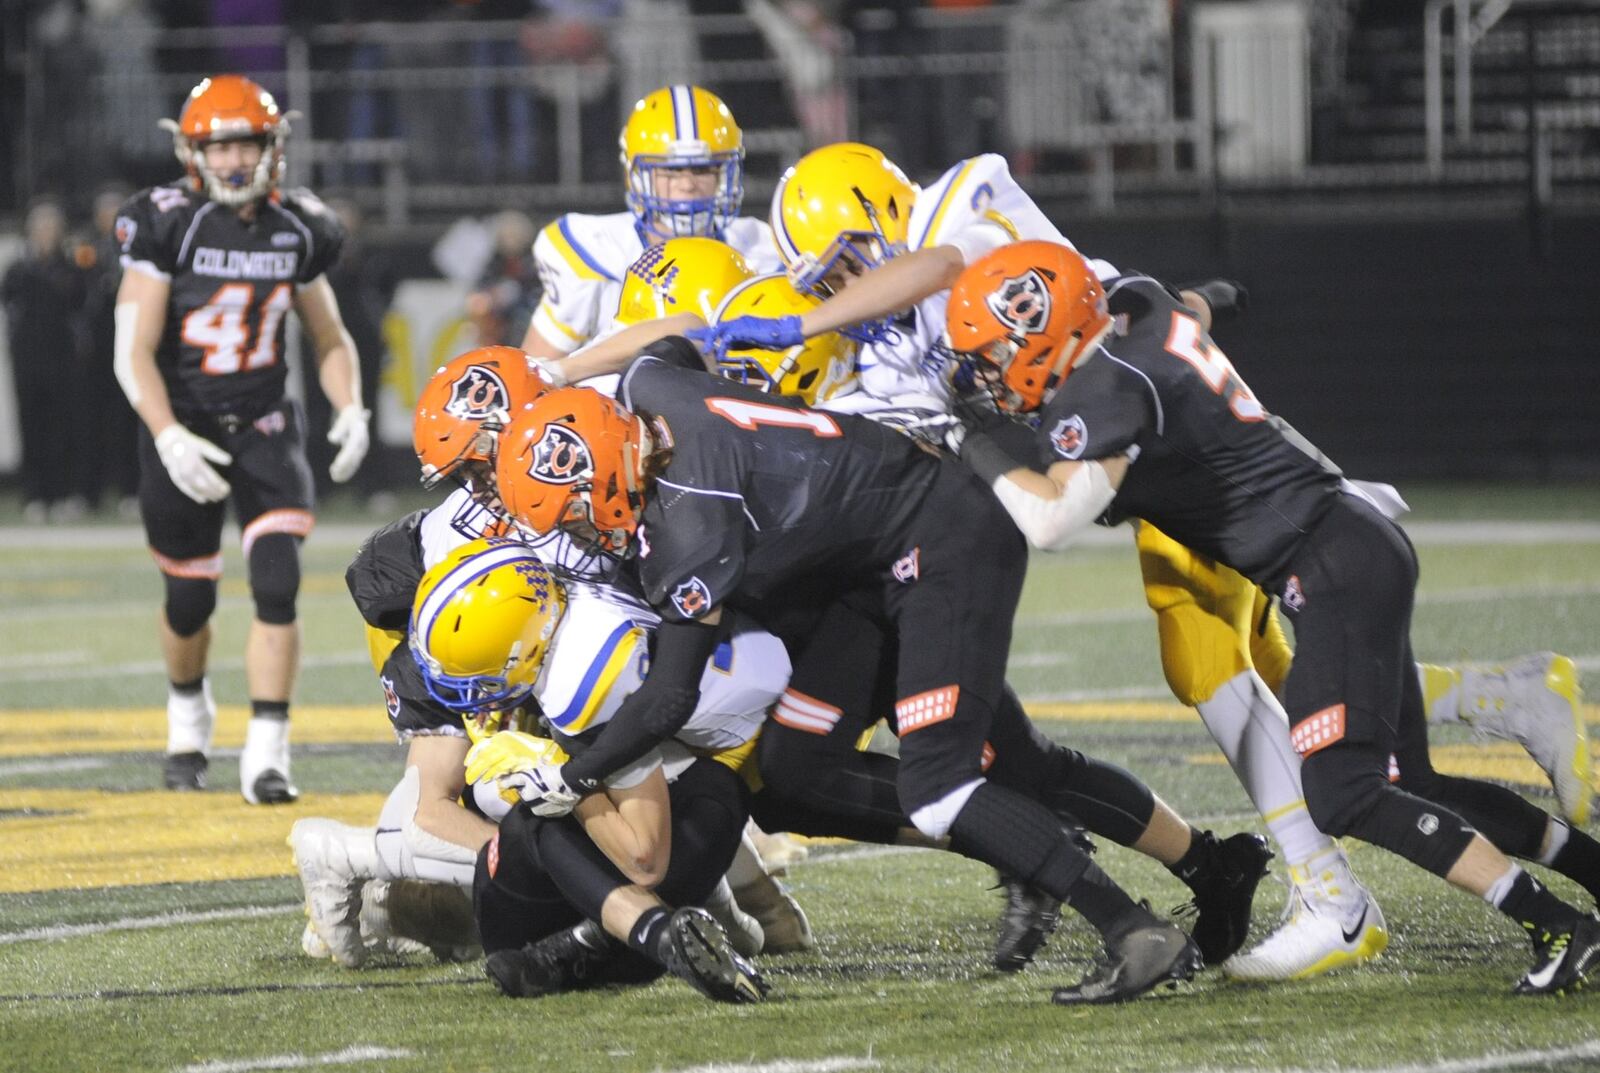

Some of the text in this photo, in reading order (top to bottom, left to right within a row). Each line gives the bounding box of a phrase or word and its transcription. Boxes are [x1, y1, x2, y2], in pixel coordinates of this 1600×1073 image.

[193, 248, 299, 279] COLDWATER
[181, 282, 294, 376] 41
[1164, 310, 1267, 423] 5
[703, 396, 844, 438] 1
